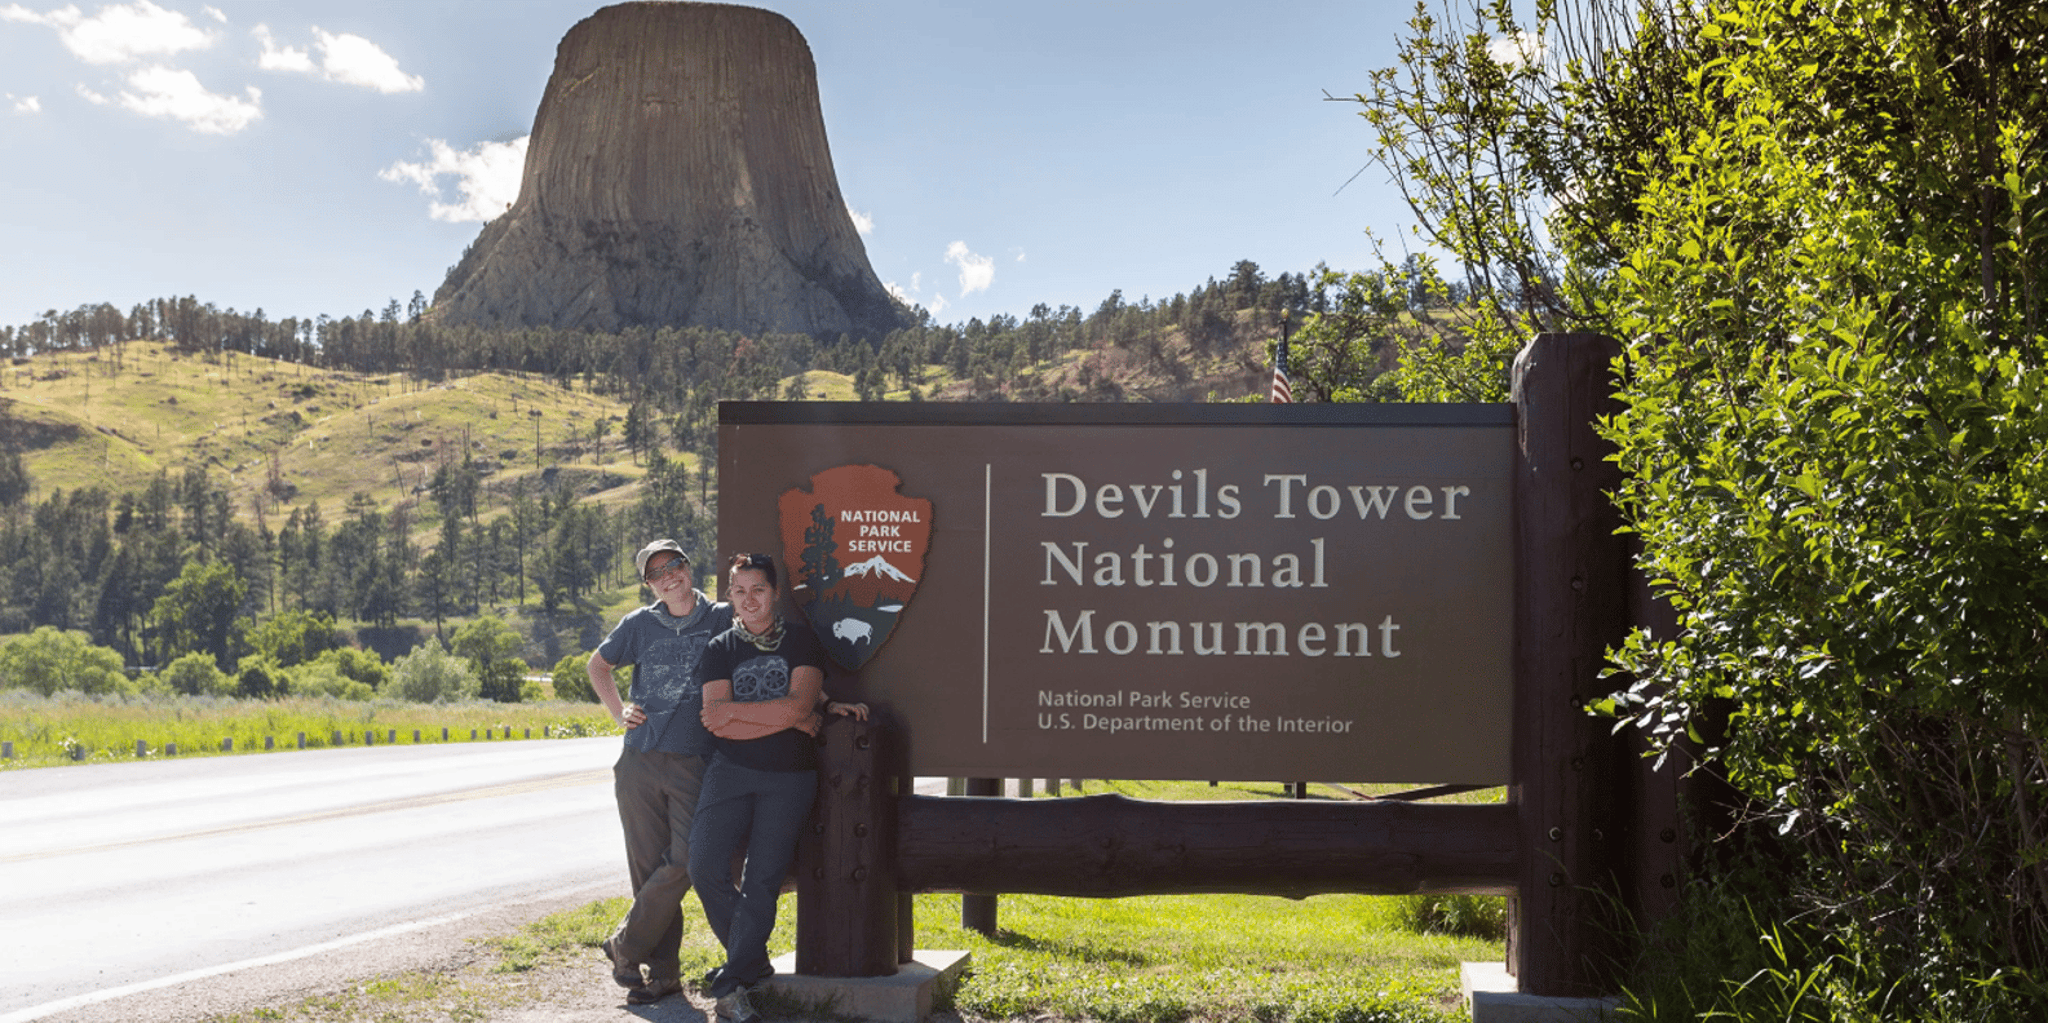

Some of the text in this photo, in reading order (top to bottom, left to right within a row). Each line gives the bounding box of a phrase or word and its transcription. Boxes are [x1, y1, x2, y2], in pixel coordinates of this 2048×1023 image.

[1041, 469, 1470, 520] Devils Tower
[841, 510, 921, 523] NATIONAL
[860, 525, 901, 537] PARK
[848, 539, 912, 553] SERVICE
[1040, 538, 1329, 588] National
[1039, 609, 1401, 658] Monument
[1038, 689, 1251, 709] National Park Service
[1038, 712, 1353, 734] U.S. Department of the Interior
